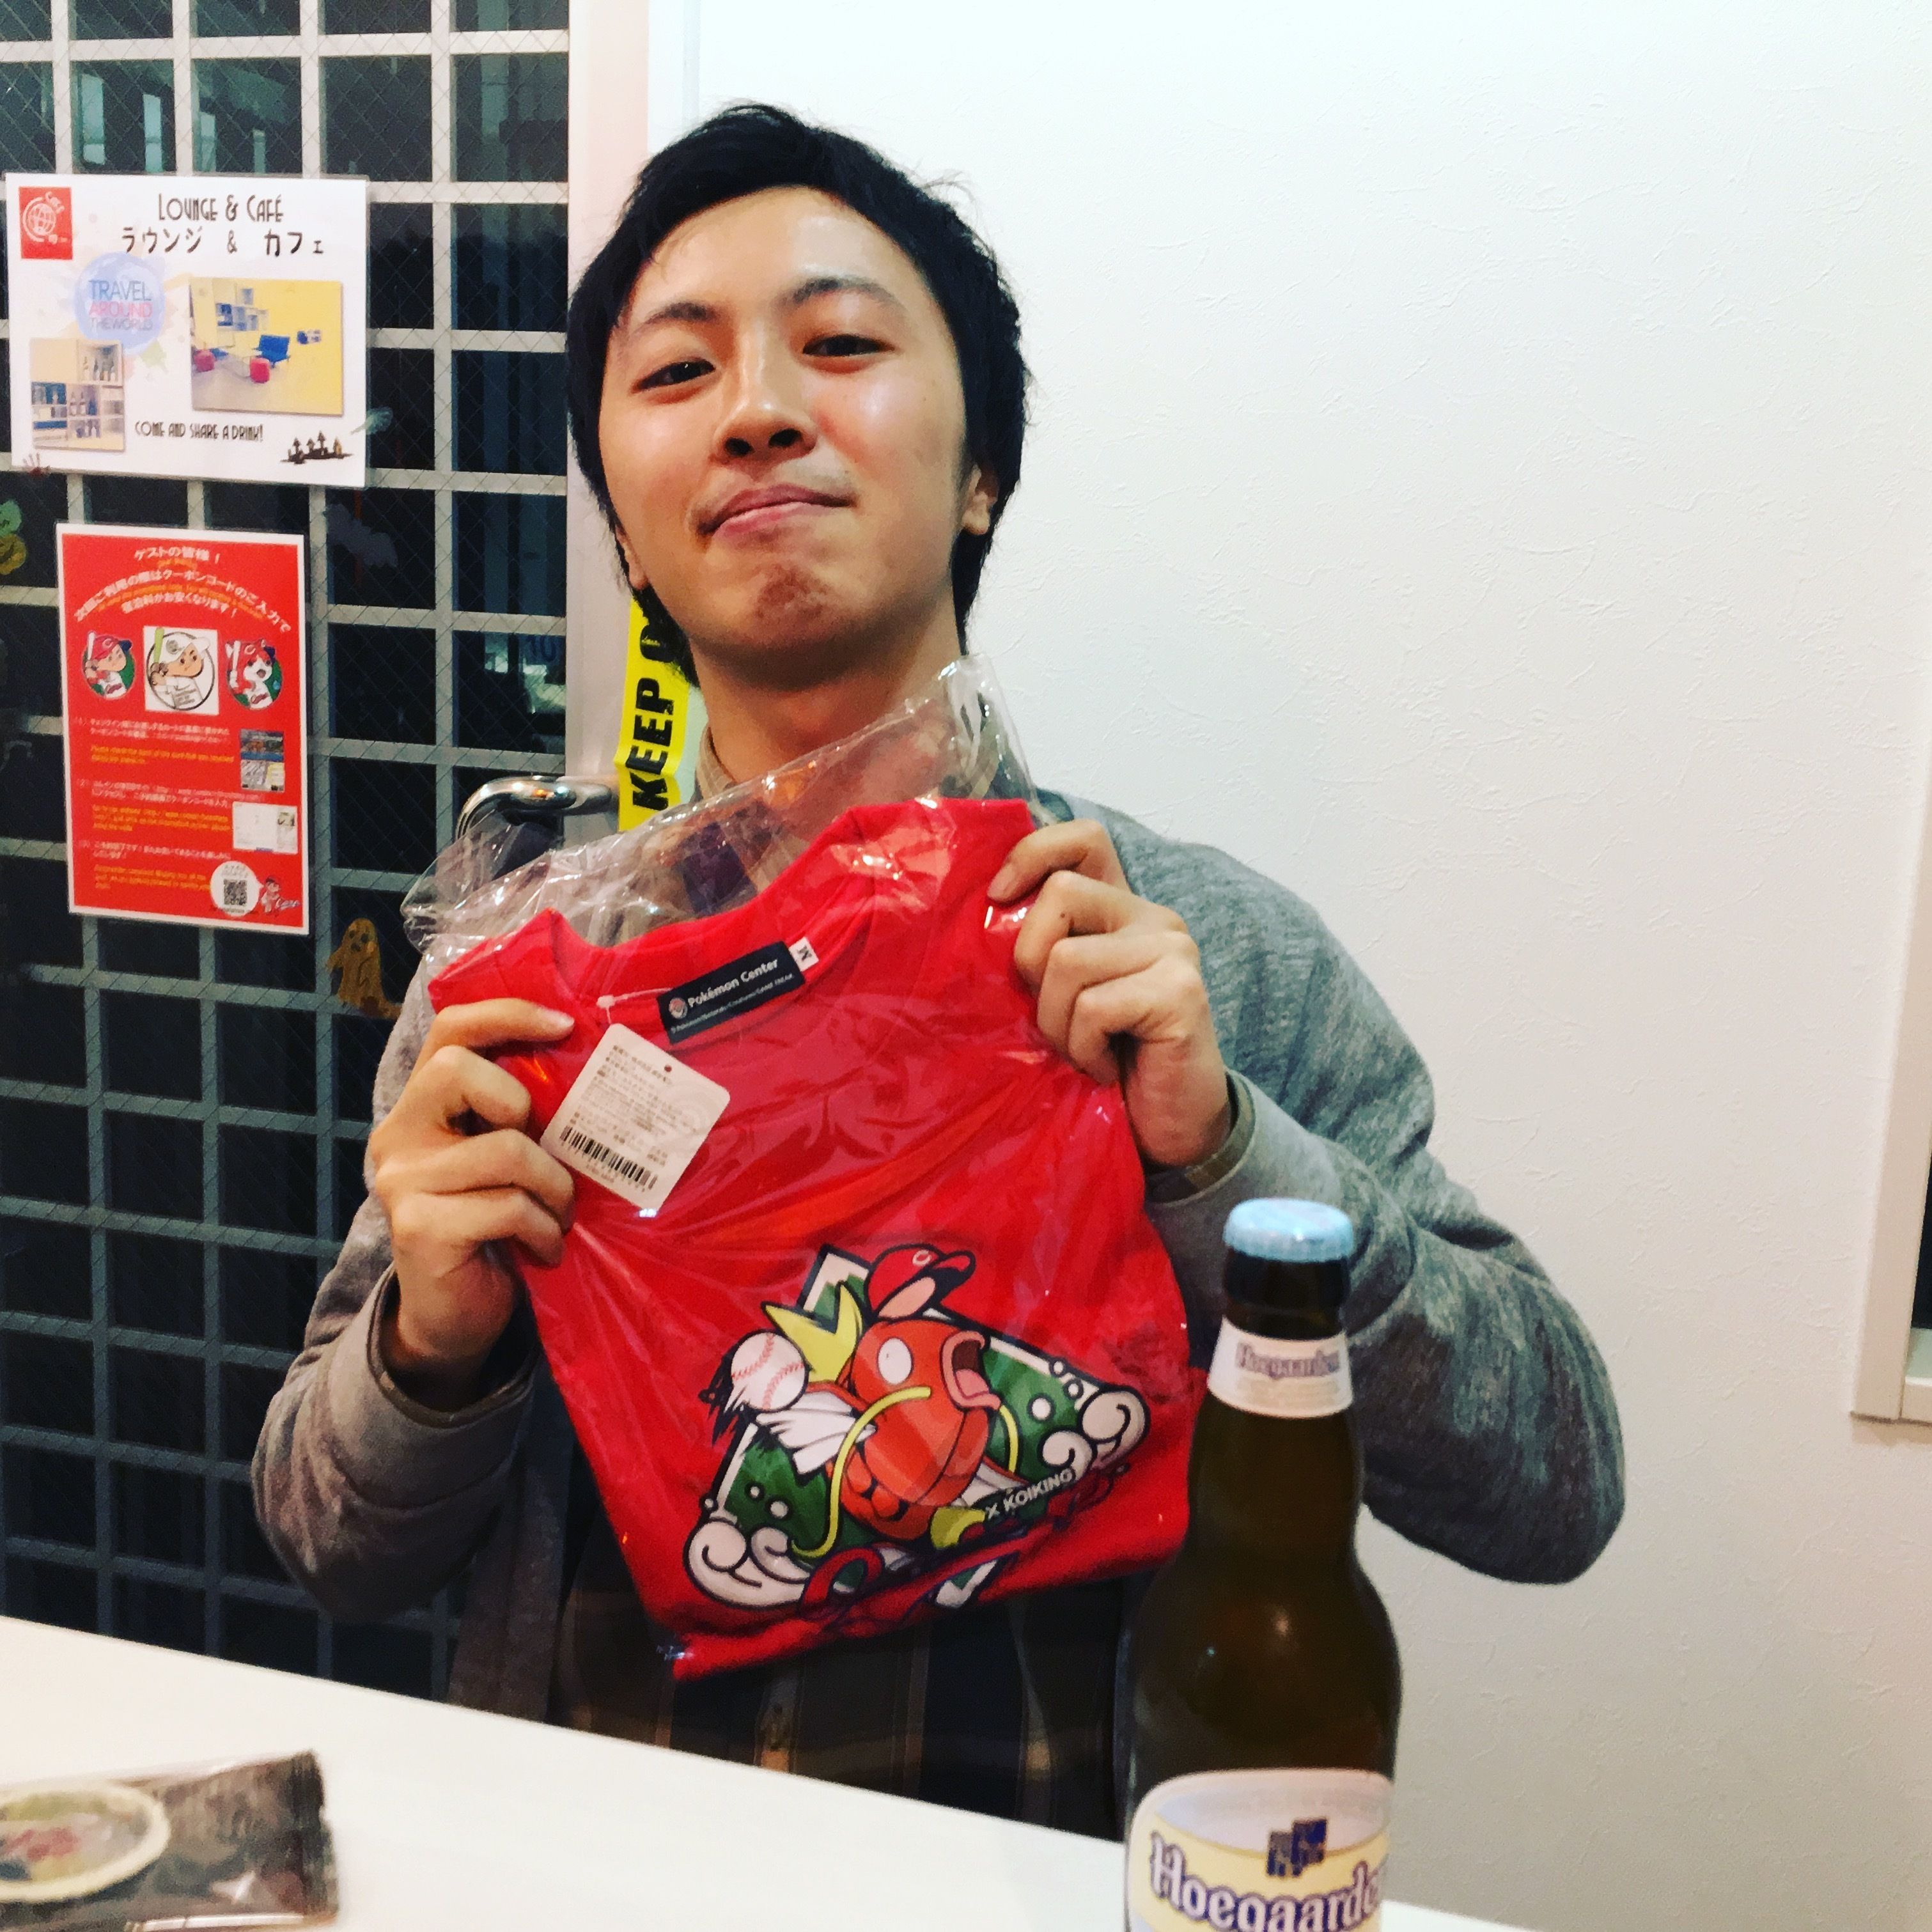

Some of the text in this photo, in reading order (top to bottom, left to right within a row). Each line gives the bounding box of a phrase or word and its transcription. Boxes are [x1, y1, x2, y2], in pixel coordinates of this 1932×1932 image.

[225, 194, 238, 221] &
[121, 225, 324, 257] ラウンジ & カフェ
[89, 280, 152, 300] TRAVEL
[89, 300, 153, 317] AROUND
[625, 677, 674, 811] KEEP
[687, 977, 740, 1008] Pokémon
[740, 958, 779, 983] Center
